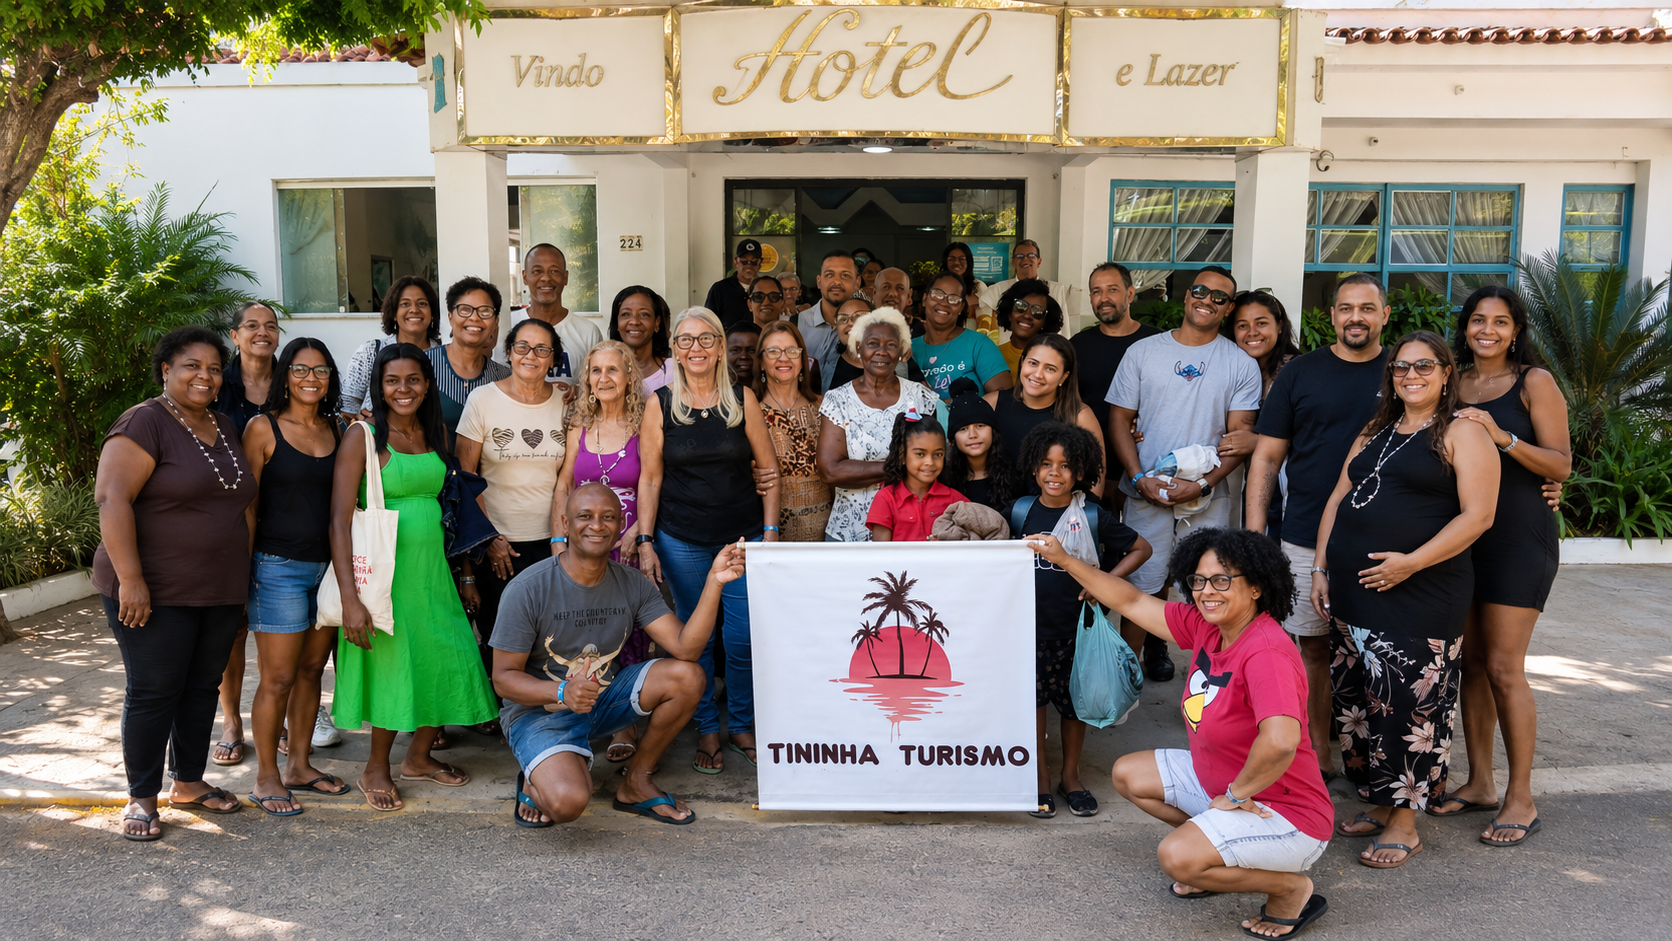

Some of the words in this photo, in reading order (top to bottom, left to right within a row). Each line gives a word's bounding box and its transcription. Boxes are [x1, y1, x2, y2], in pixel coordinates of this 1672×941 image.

[510, 52, 605, 87] Vindo
[712, 8, 1014, 106] Hotel
[1115, 63, 1134, 87] e
[1143, 53, 1238, 87] Lazer
[620, 238, 642, 249] 224
[767, 743, 880, 766] TININHA
[898, 744, 1031, 767] TURISMO
